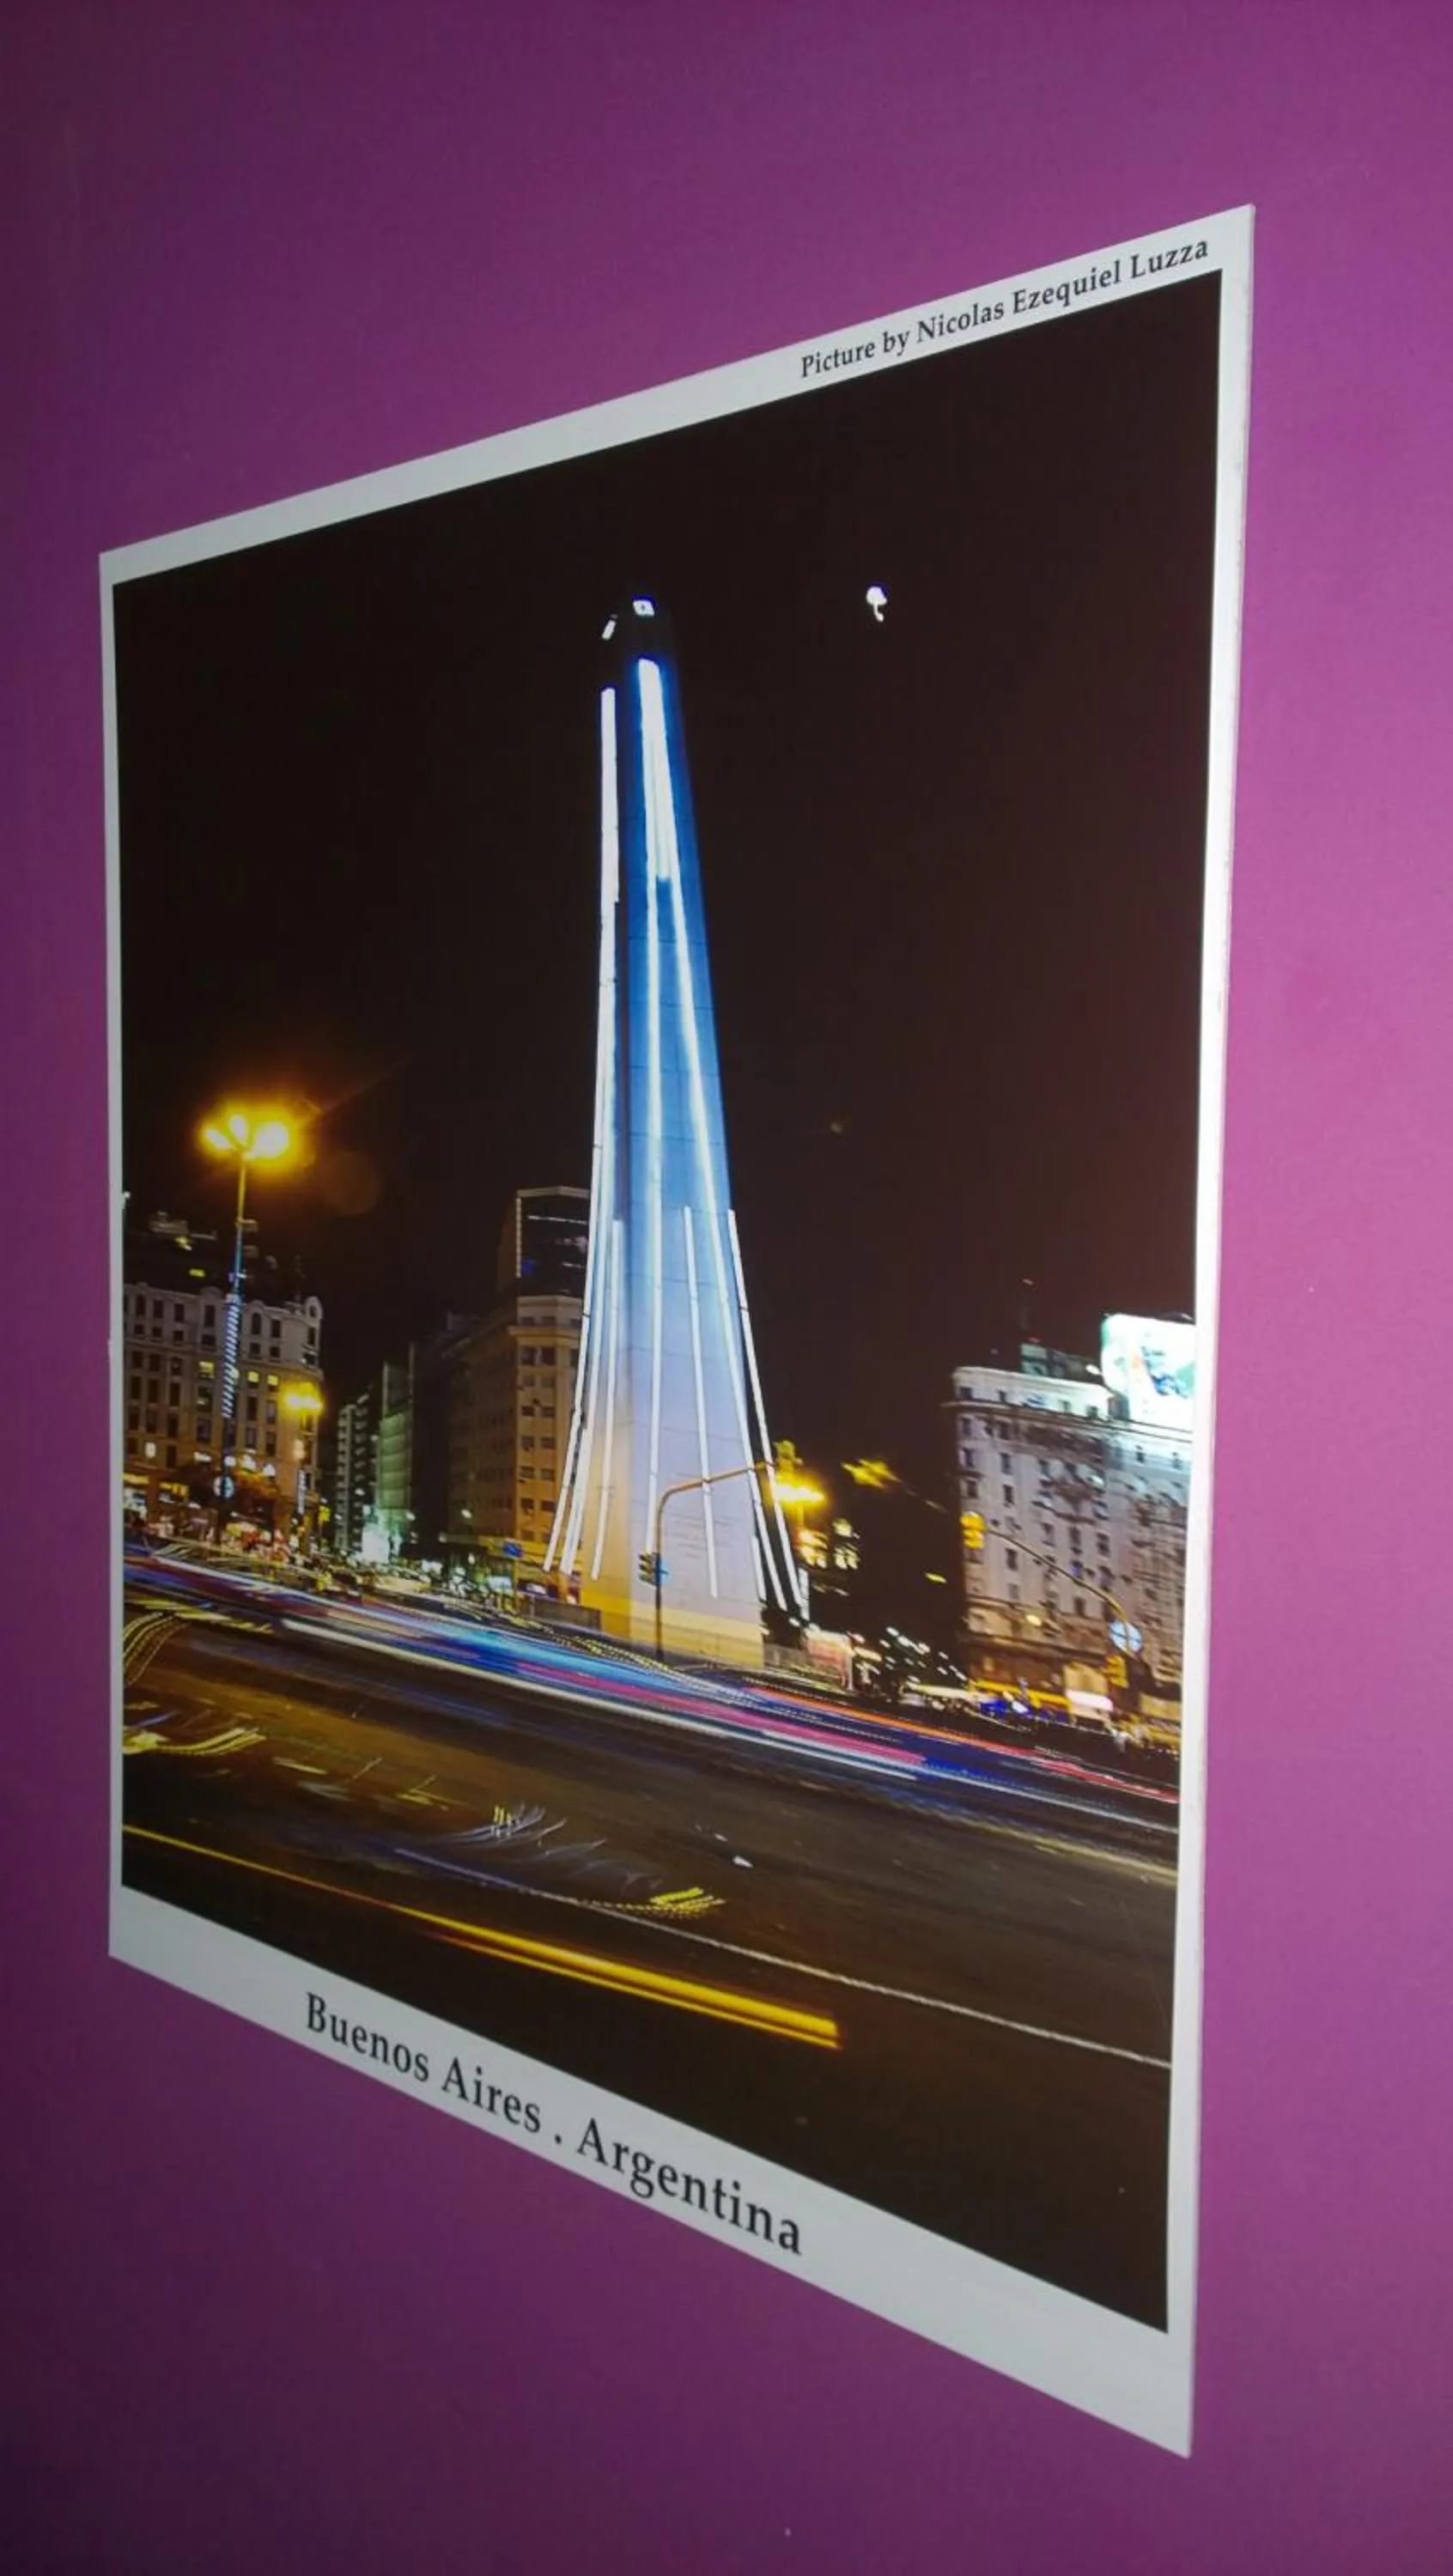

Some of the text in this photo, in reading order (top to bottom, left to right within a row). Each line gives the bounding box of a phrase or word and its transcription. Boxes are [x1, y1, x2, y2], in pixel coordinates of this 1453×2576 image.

[801, 240, 1209, 378] Picture by Nicolas Ezequiel Luzza
[306, 1991, 429, 2081] Buenos
[441, 2057, 543, 2133] Aires
[577, 2117, 802, 2257] Argentina
